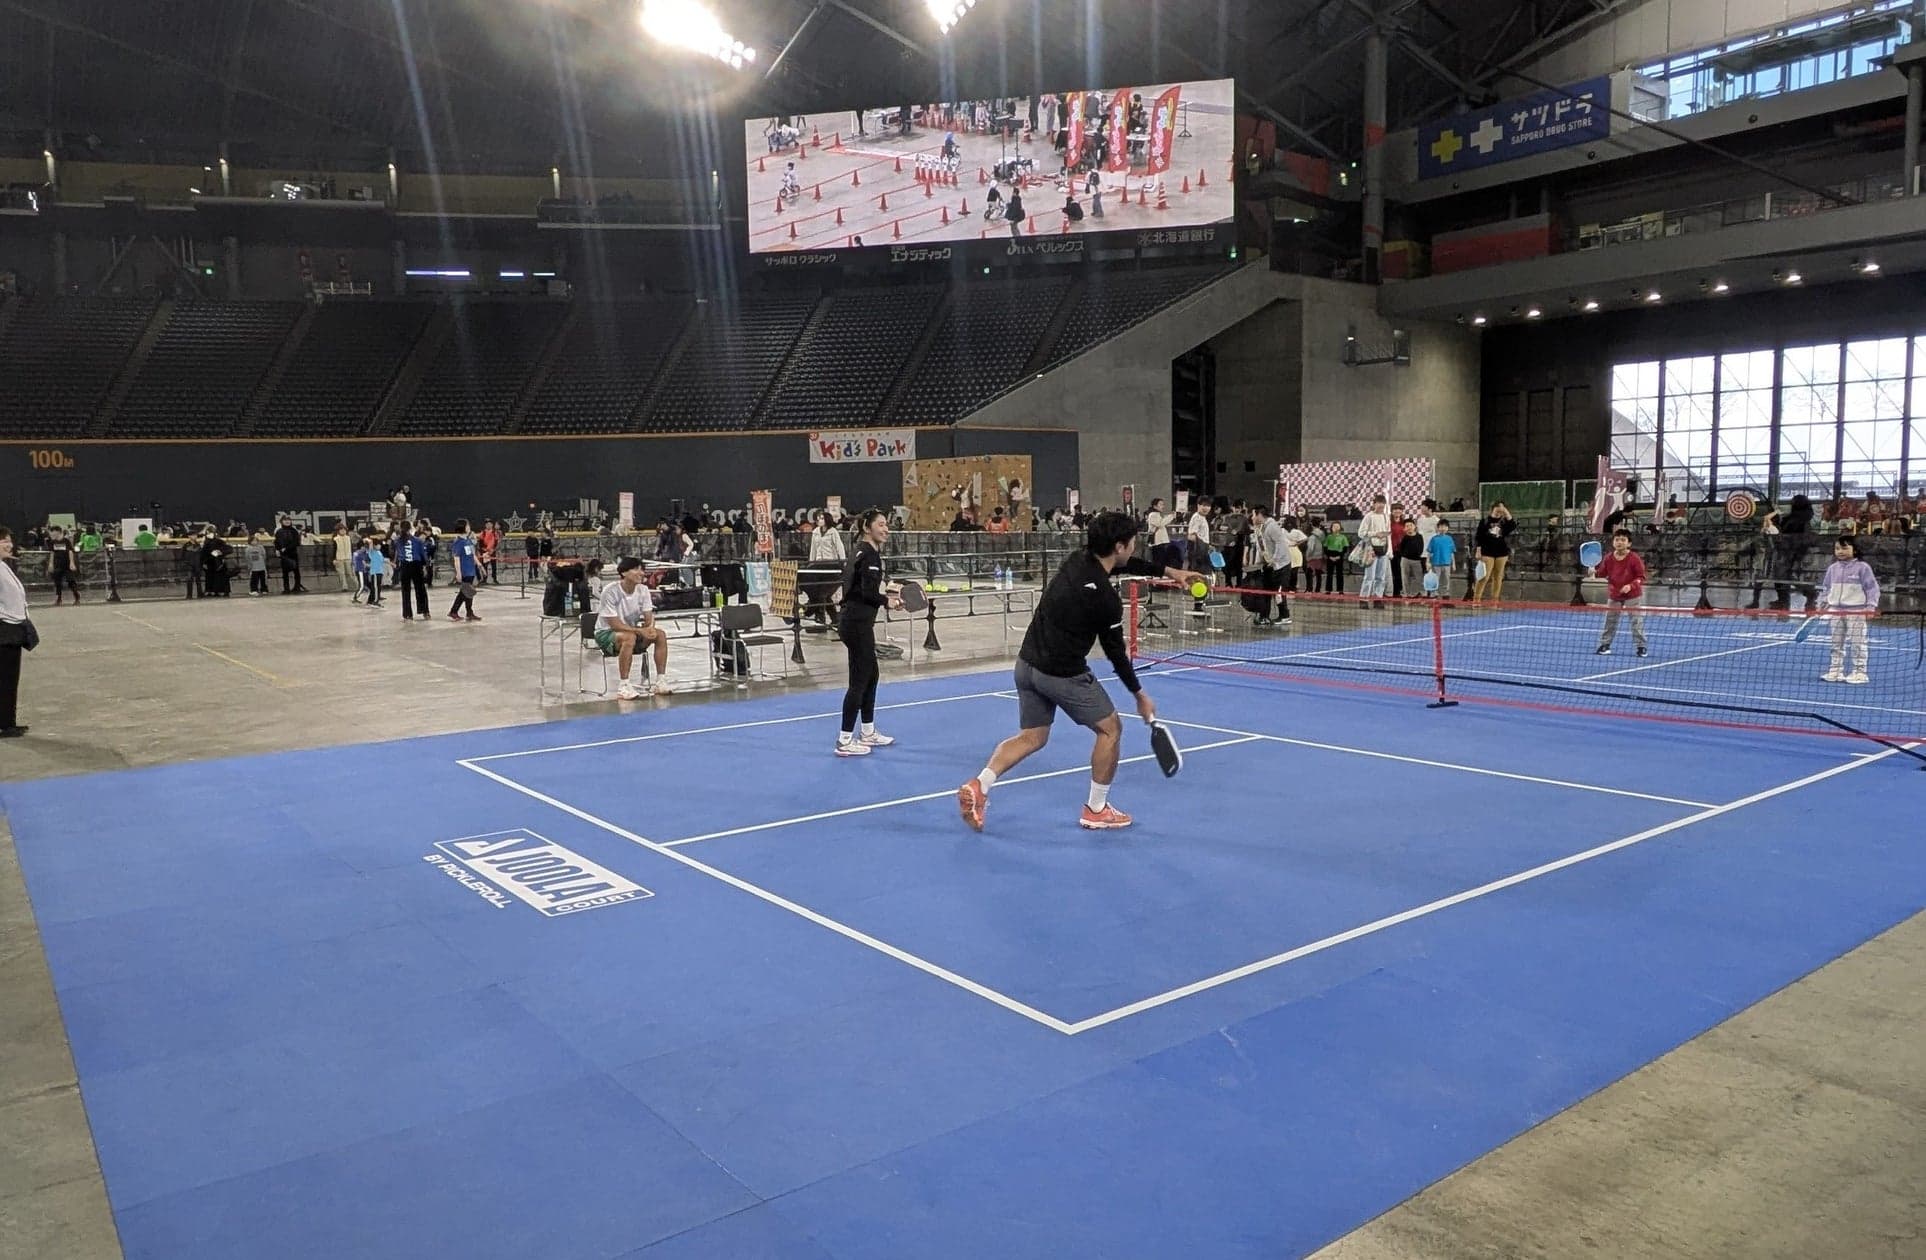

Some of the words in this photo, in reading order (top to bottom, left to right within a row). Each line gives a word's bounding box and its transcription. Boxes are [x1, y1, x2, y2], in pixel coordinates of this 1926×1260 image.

[1510, 93, 1593, 131] サツドラ
[1511, 128, 1544, 145] SAPPORO
[1546, 123, 1566, 137] DRUG
[1568, 116, 1593, 132] STORE
[1152, 228, 1216, 245] 北海道銀行
[819, 439, 862, 460] Kid's
[866, 438, 906, 457] Park
[422, 853, 444, 864] BY
[436, 861, 514, 909] PICKLEROLL
[484, 851, 617, 904] JOOLA
[555, 890, 637, 912] COURT
